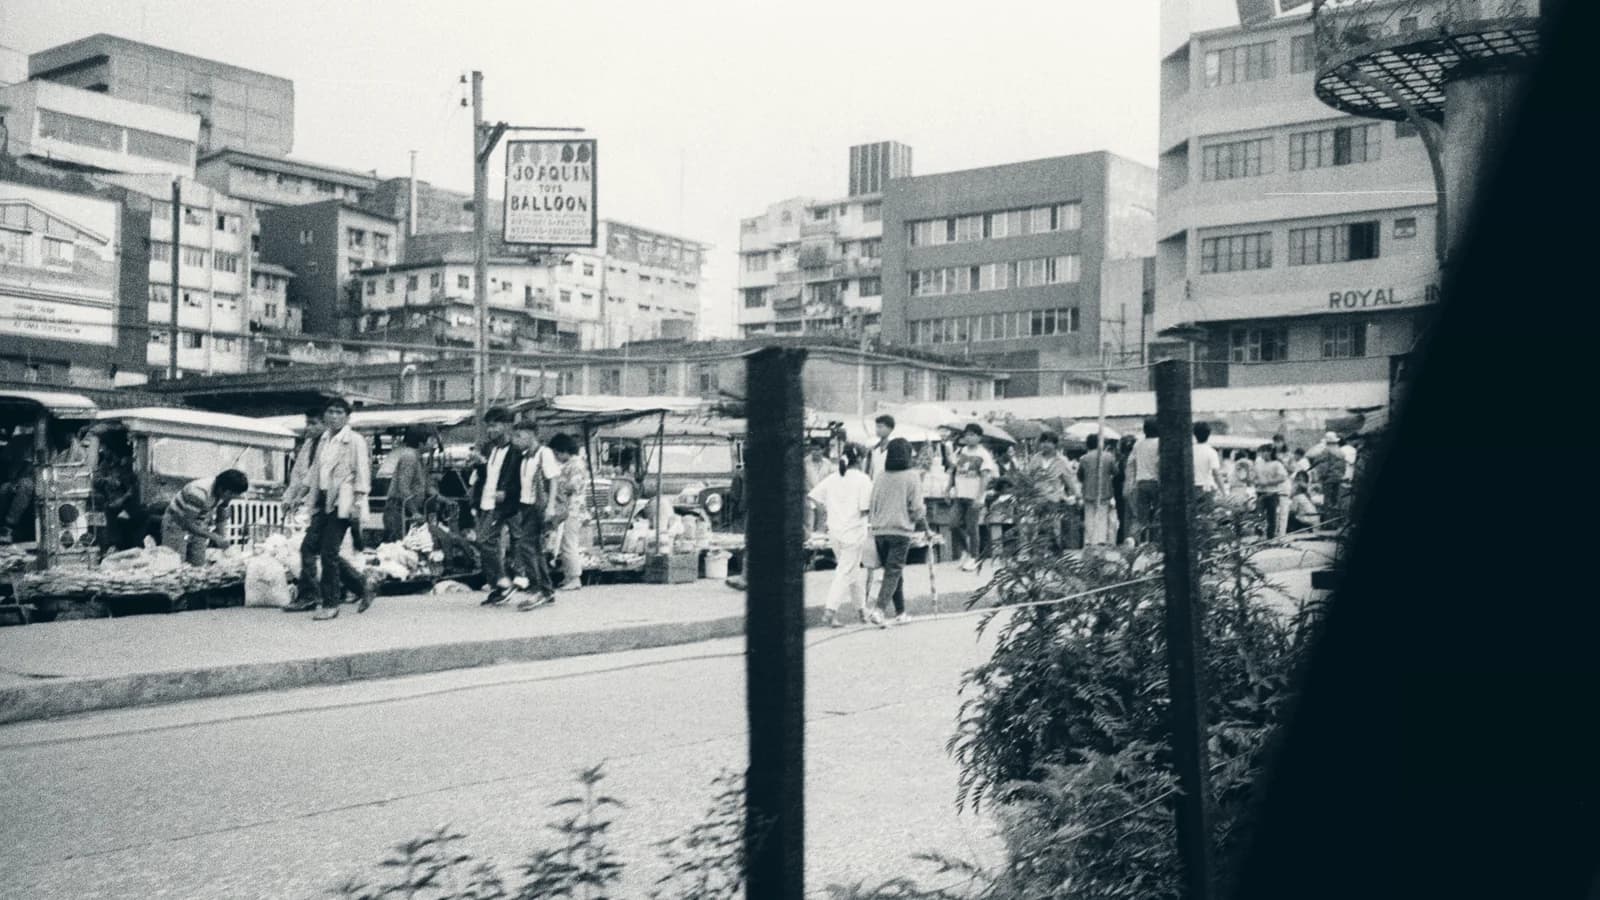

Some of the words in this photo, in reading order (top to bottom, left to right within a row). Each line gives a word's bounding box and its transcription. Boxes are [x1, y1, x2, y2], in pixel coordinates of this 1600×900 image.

[513, 165, 590, 182] JOAQUIN
[539, 184, 563, 193] TOYS
[511, 195, 587, 212] BALLOON
[1328, 288, 1403, 309] ROYAL
